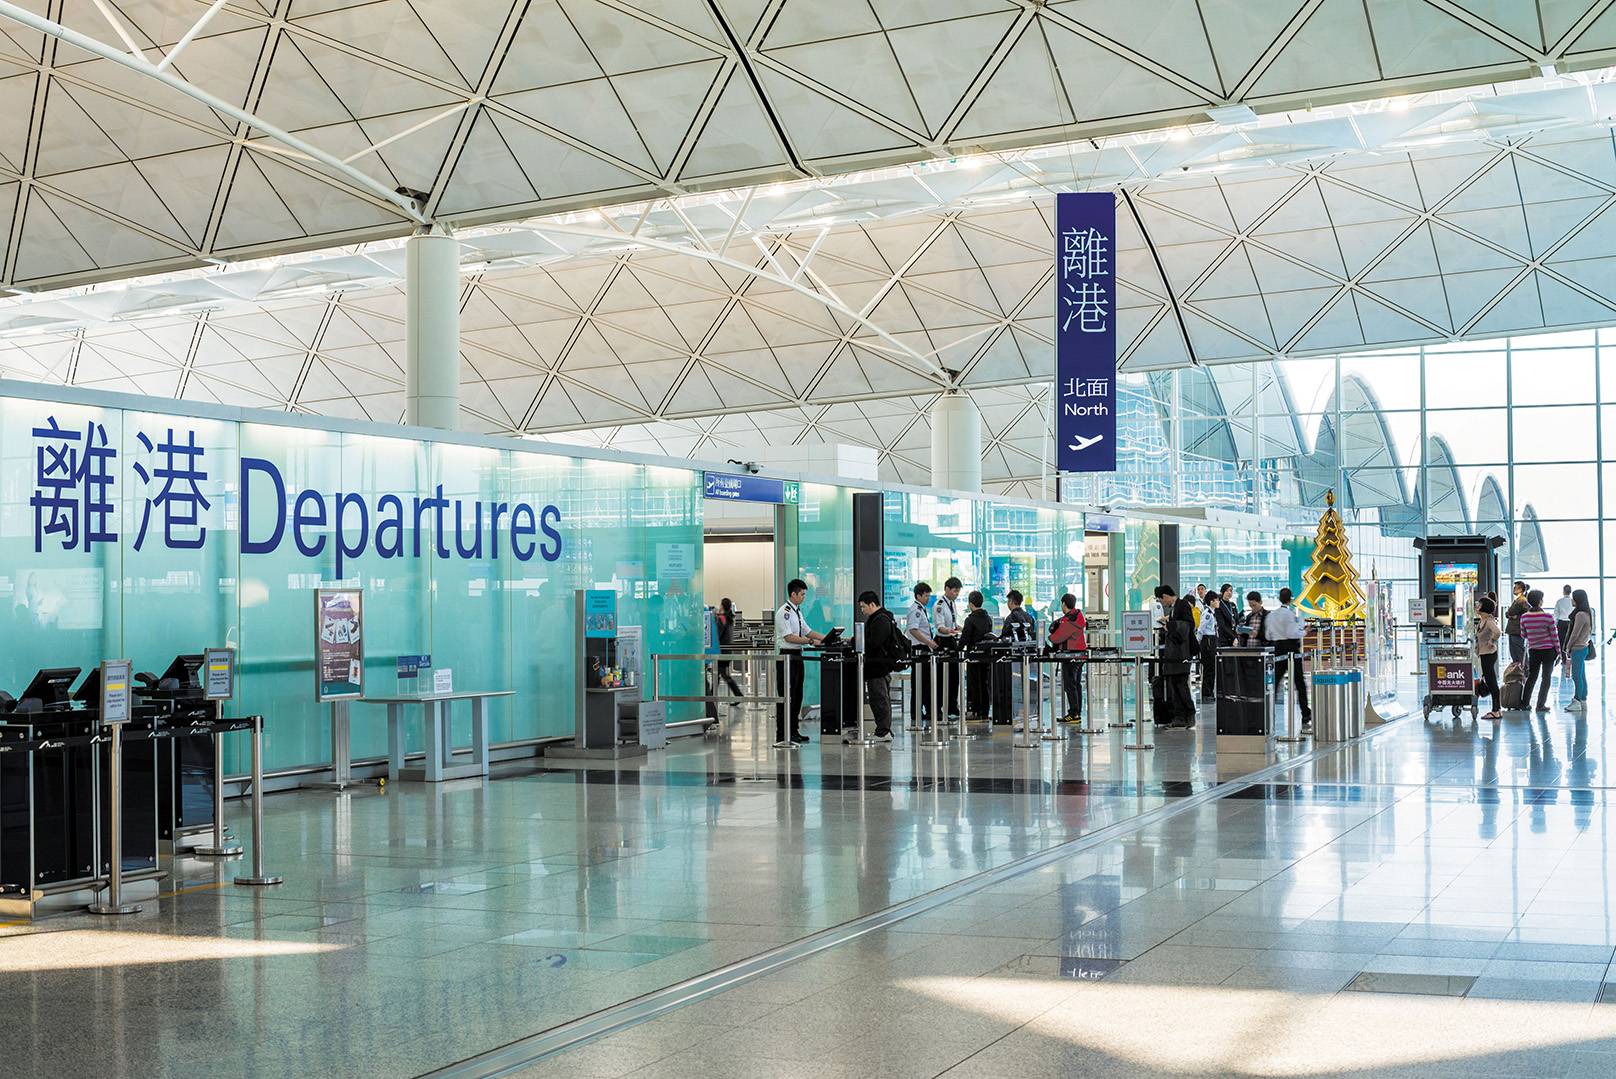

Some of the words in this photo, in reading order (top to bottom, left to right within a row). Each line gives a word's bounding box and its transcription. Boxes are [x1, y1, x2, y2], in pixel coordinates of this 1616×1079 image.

[1062, 227, 1109, 333] 離港
[1063, 377, 1108, 397] 北面
[1064, 402, 1109, 416] North
[30, 415, 211, 553] 離港
[240, 457, 562, 580] Departures
[1436, 666, 1465, 679] Bank
